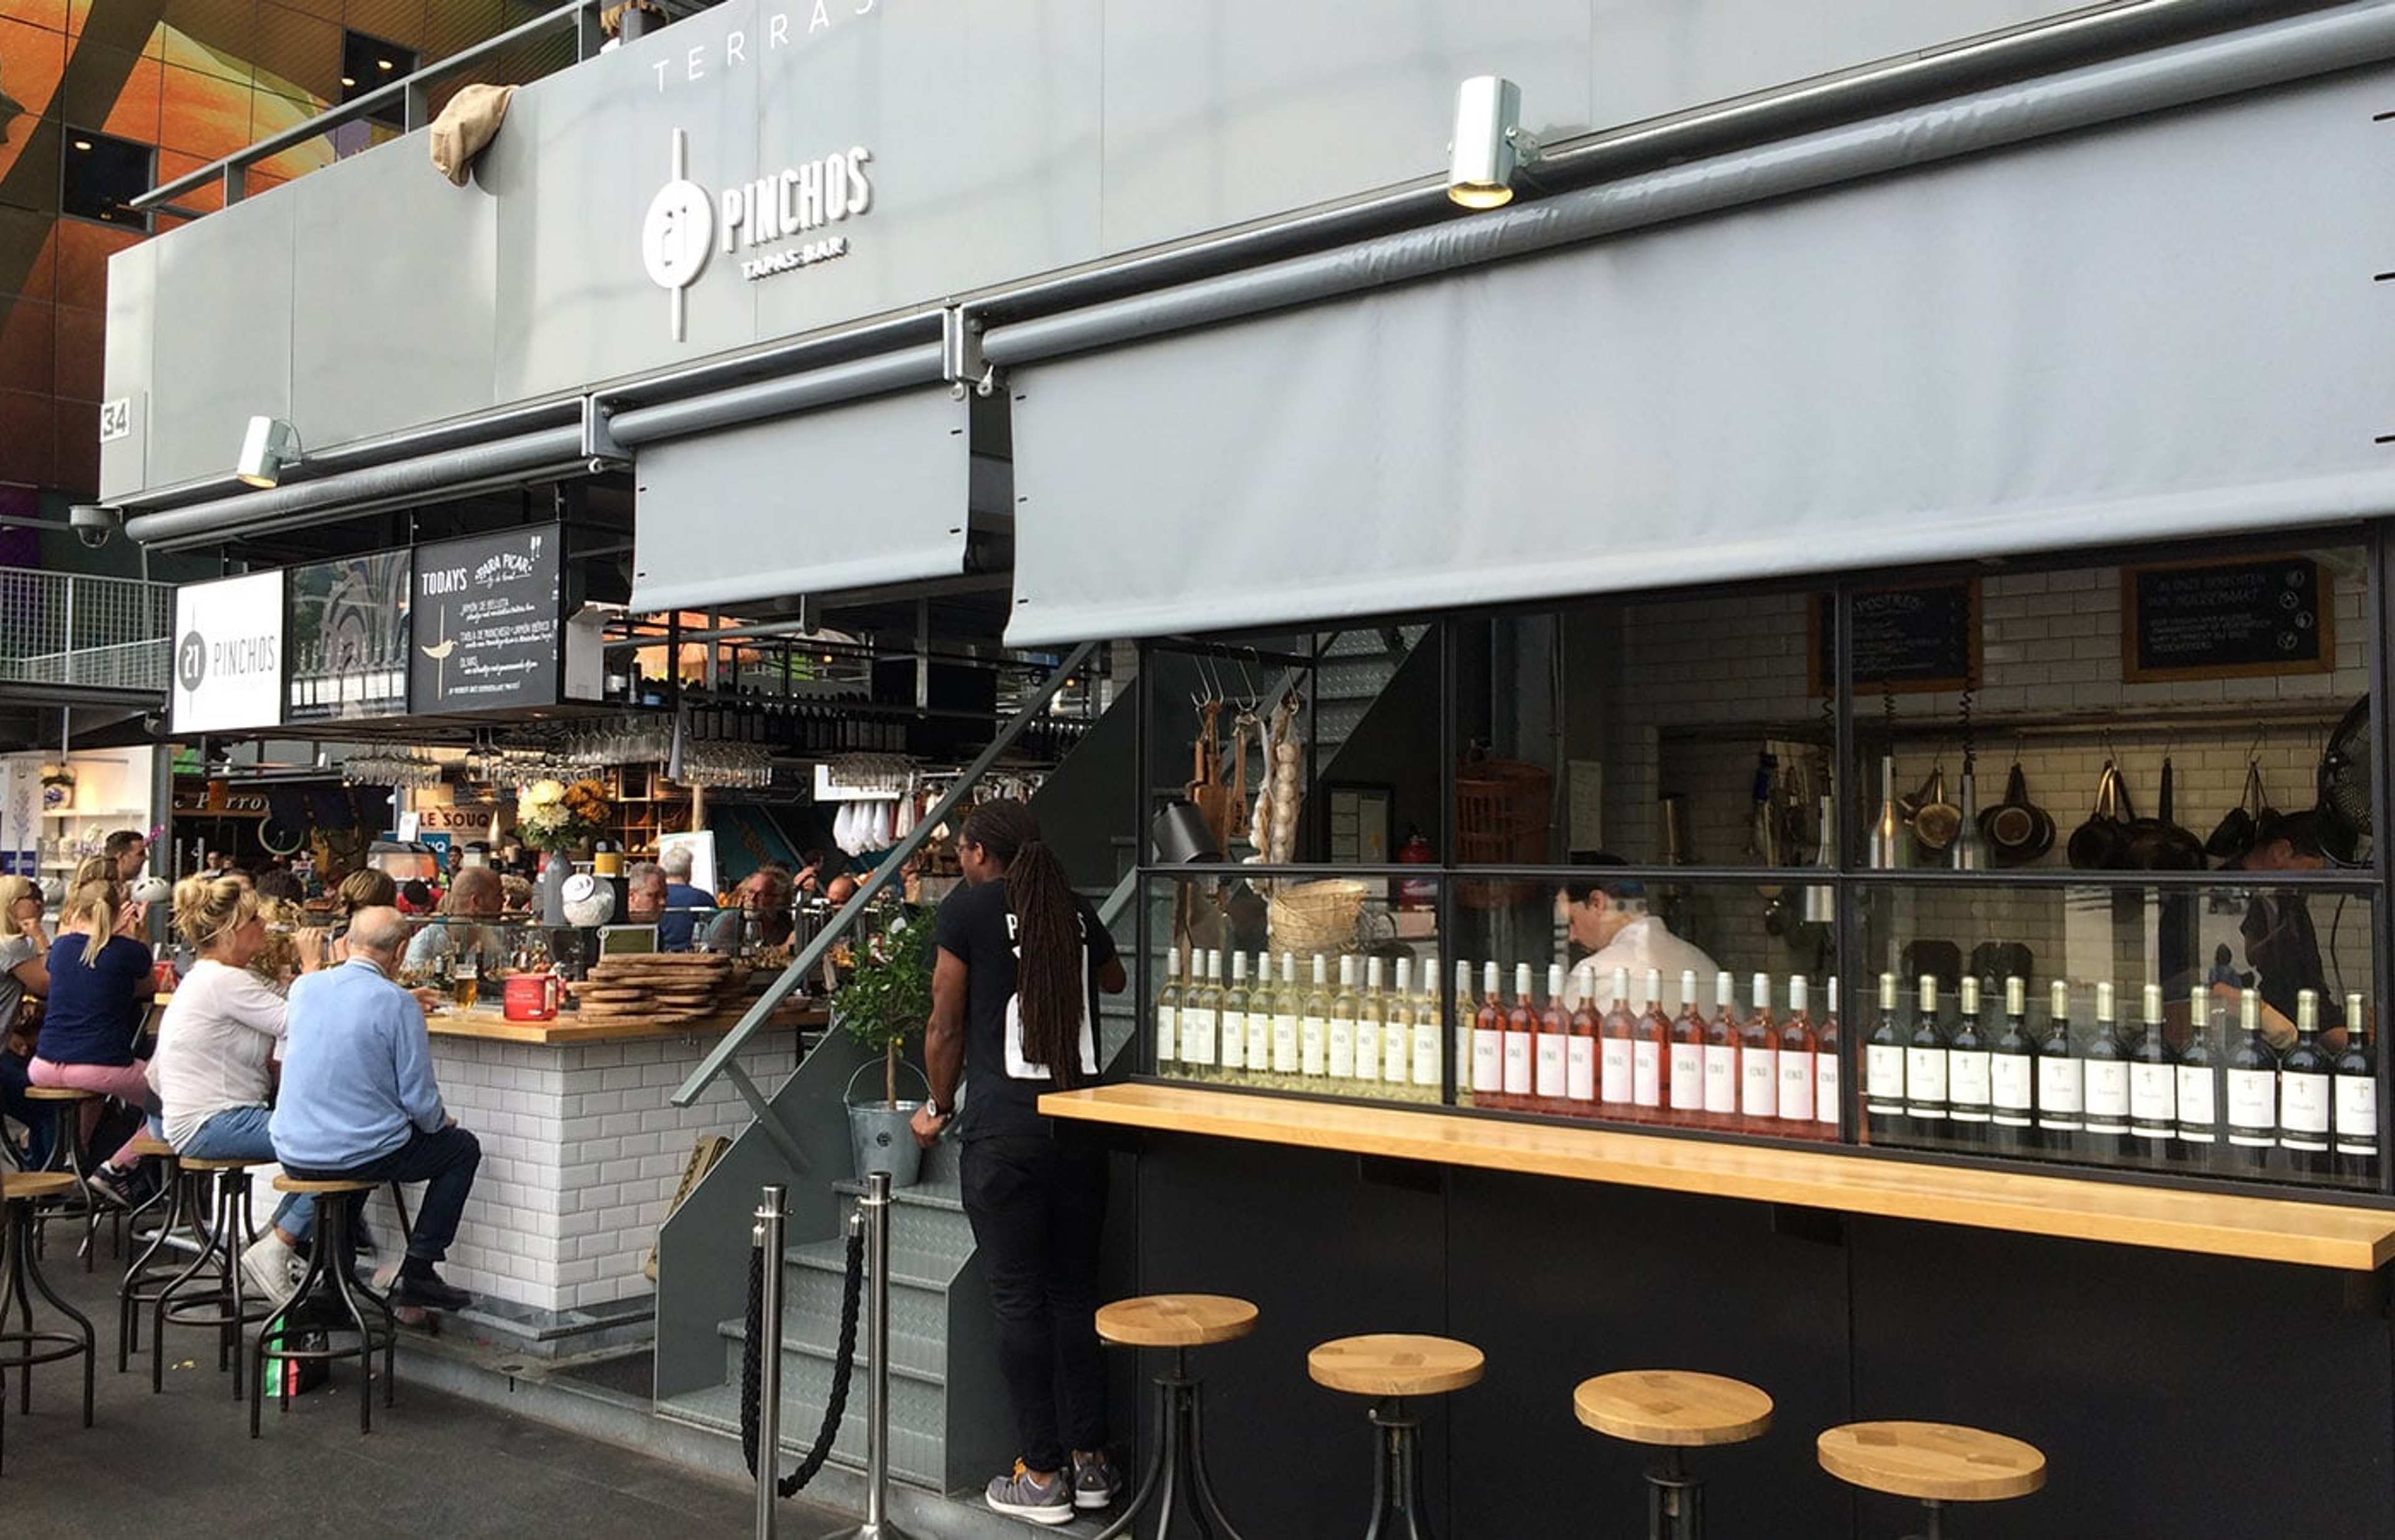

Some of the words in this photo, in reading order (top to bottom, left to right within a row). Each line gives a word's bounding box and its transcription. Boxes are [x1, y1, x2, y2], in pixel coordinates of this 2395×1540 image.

[722, 146, 871, 252] PINCHOS
[104, 403, 127, 436] 34
[421, 567, 468, 596] TODAYS
[212, 634, 276, 677] PINCHOS
[195, 792, 271, 810] Prro
[419, 812, 437, 827] LE
[443, 812, 490, 828] SOUQ
